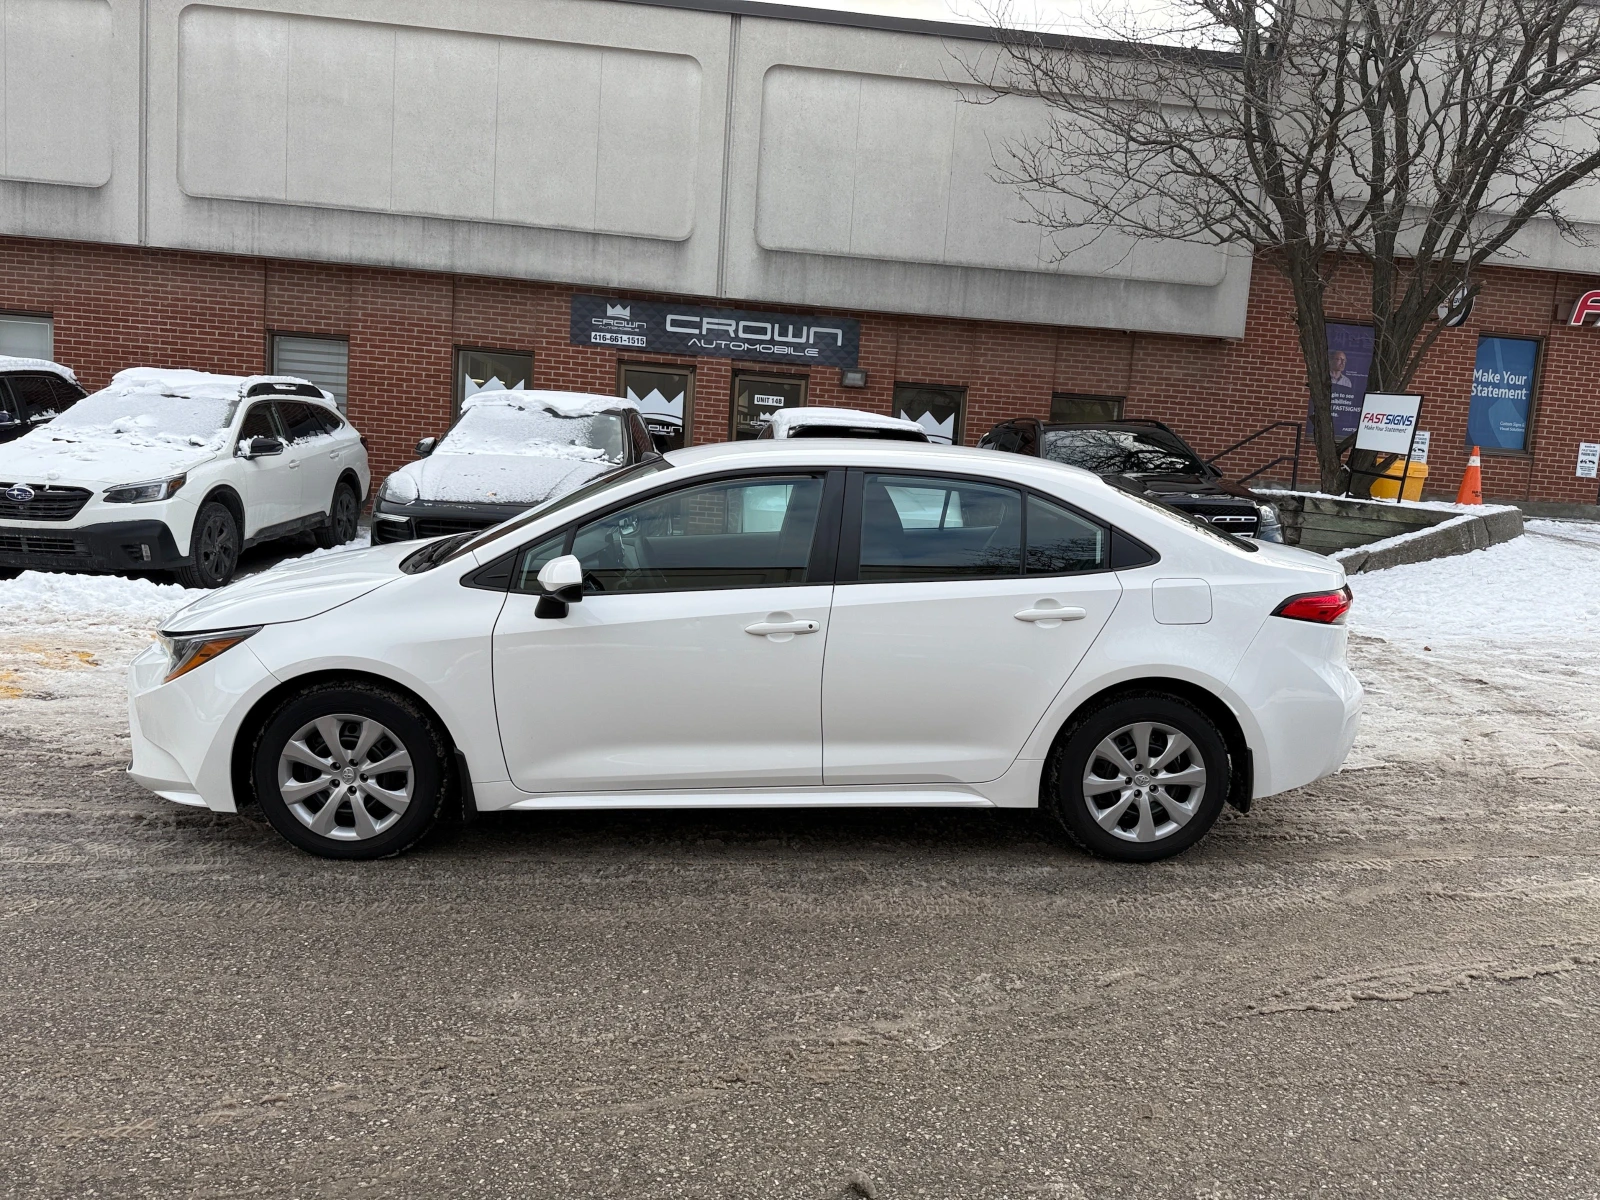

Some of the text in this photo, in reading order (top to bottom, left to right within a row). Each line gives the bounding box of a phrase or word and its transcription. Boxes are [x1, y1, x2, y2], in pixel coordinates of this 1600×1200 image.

[592, 318, 646, 329] CROWN
[665, 314, 842, 346] CROWN
[593, 334, 645, 345] 416-661-1515
[688, 338, 819, 357] AUTOMOBILE
[1473, 369, 1527, 385] Make Your
[1471, 383, 1527, 400] Statement
[756, 396, 770, 404] UNIT
[1362, 412, 1414, 426] FASTSIGNS
[648, 424, 682, 432] OWN
